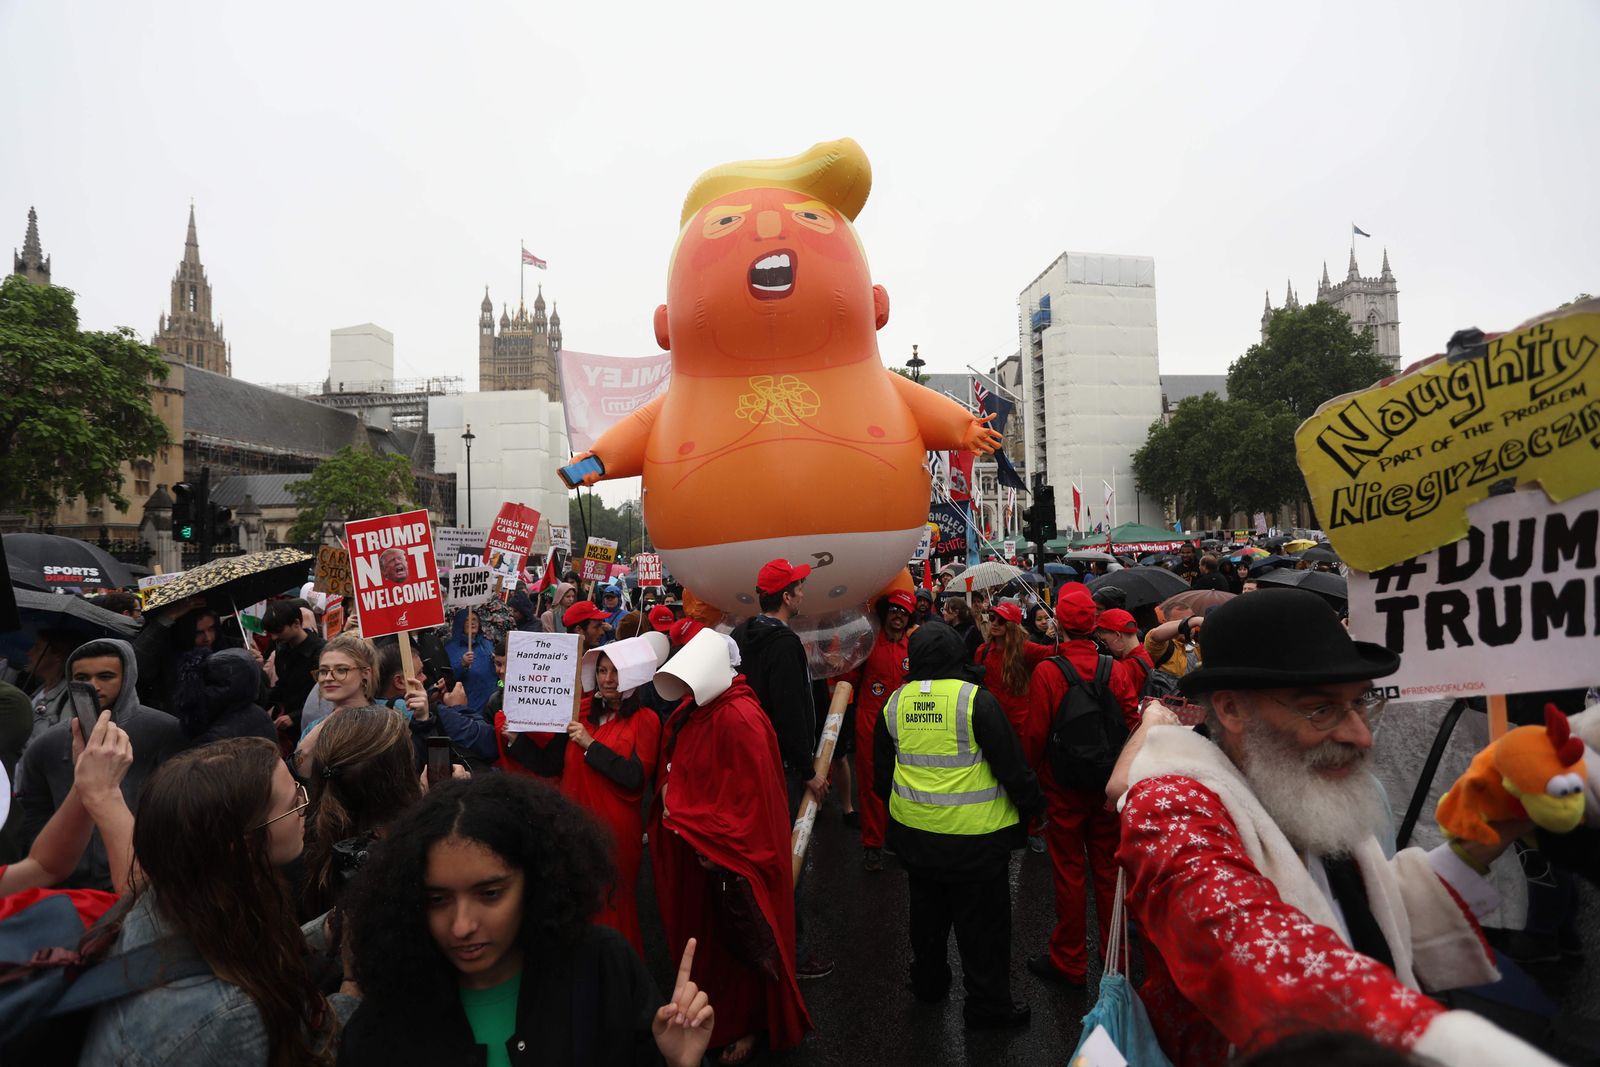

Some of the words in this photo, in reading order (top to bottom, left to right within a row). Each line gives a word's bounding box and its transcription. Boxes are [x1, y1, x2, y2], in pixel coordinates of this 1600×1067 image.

[1378, 444, 1424, 473] PART
[1431, 435, 1454, 453] OF
[1460, 421, 1494, 440] THE
[1500, 382, 1587, 428] PROBLEM
[497, 517, 512, 526] THIS
[520, 522, 534, 531] THE
[496, 525, 529, 538] CARNIVAL
[352, 522, 426, 553] TRUMP
[489, 538, 528, 553] RESISTANCE
[589, 545, 599, 553] NO
[600, 547, 609, 555] TO
[1113, 545, 1139, 553] Socialist
[587, 552, 611, 560] RACISM
[43, 566, 99, 577] SPORTS
[639, 563, 647, 571] IN
[45, 575, 84, 583] DIRECT
[453, 571, 489, 586] #DUMP
[639, 571, 660, 580] NAME
[361, 580, 437, 611] WELCOME
[453, 583, 488, 598] TRUMP
[535, 641, 552, 649] The
[516, 651, 569, 661] Handmaid's
[532, 663, 551, 672] Tale
[528, 674, 548, 682] NOT
[508, 685, 571, 695] INSTRUCTION
[517, 697, 557, 706] MANUAL
[913, 702, 936, 711] TRUMP
[905, 713, 943, 724] BABYSITTER
